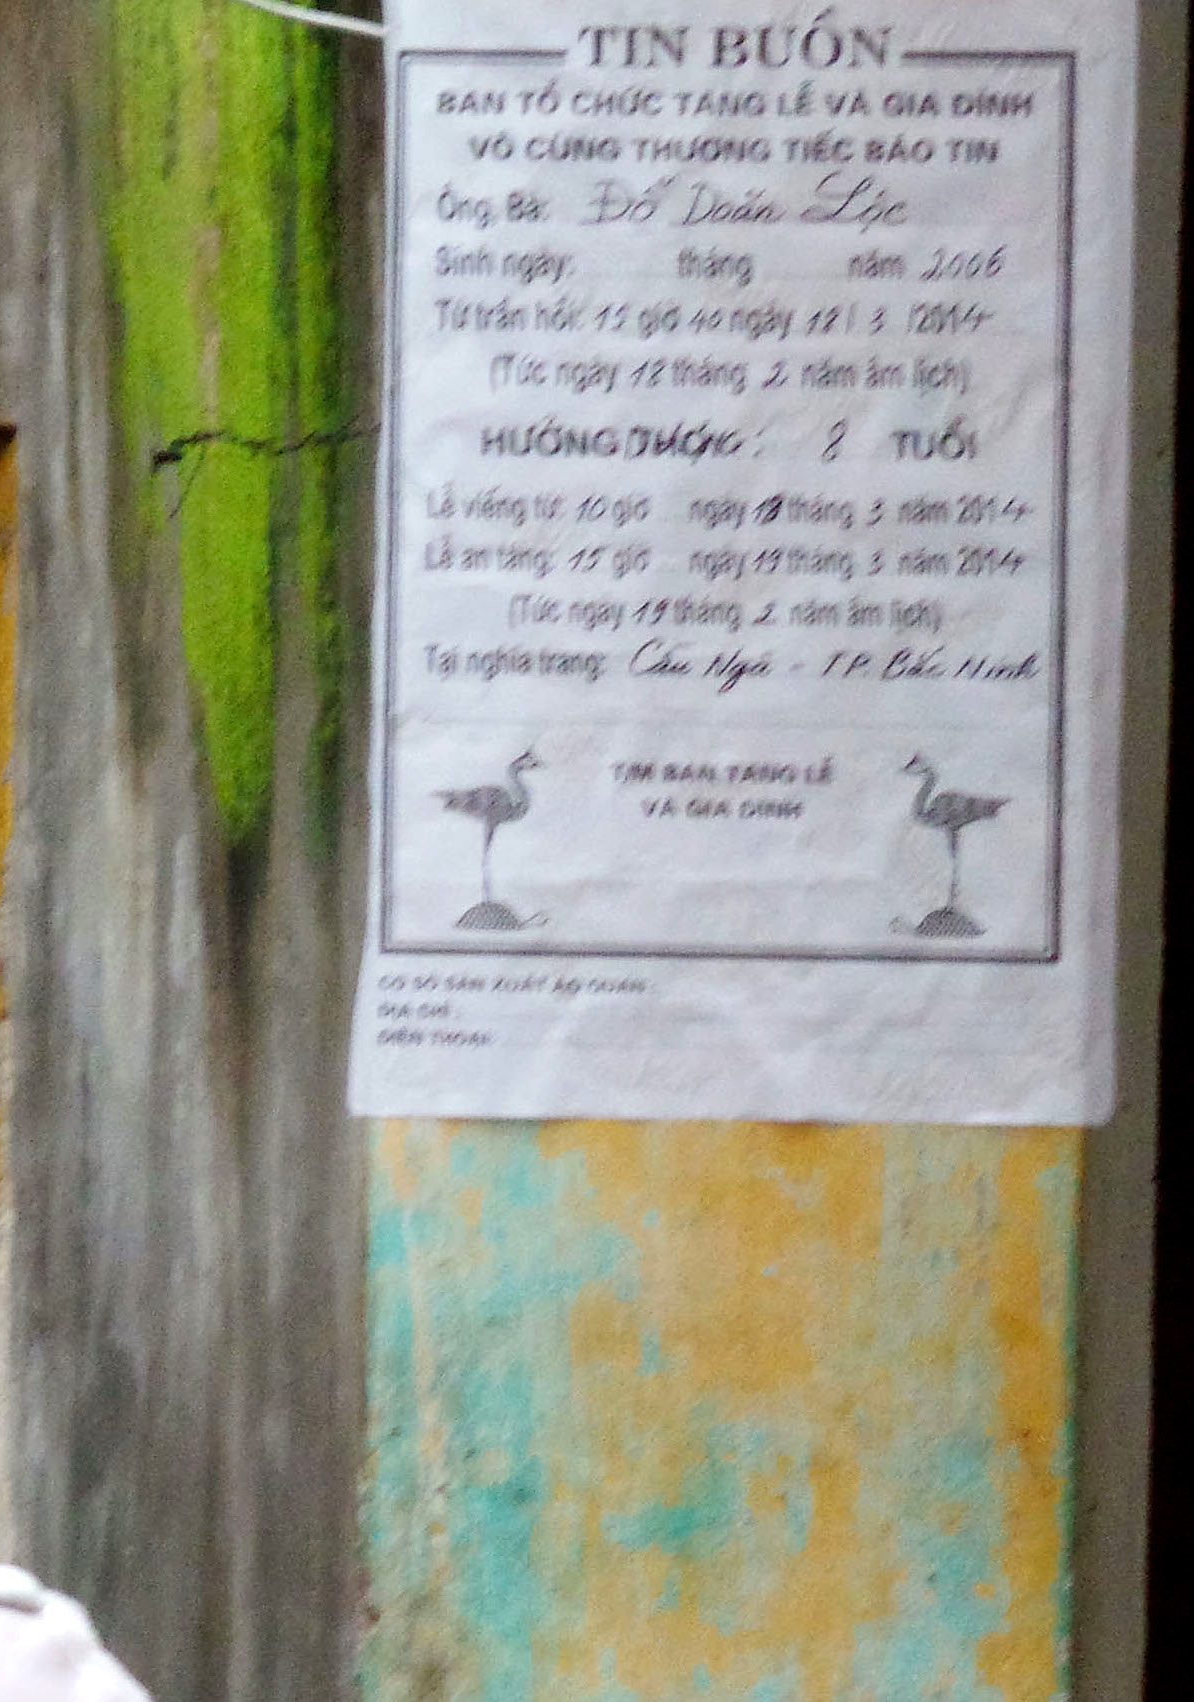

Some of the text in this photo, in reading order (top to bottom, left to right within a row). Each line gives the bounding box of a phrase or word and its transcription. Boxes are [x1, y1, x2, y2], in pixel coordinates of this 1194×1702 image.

[577, 25, 689, 68] TIN
[436, 89, 505, 116] BAN
[882, 90, 940, 118] GIA
[947, 137, 1000, 164] TIN
[436, 245, 494, 276] Sinh
[918, 243, 1008, 281] 2006
[760, 360, 790, 390] 2
[821, 418, 847, 465] 8
